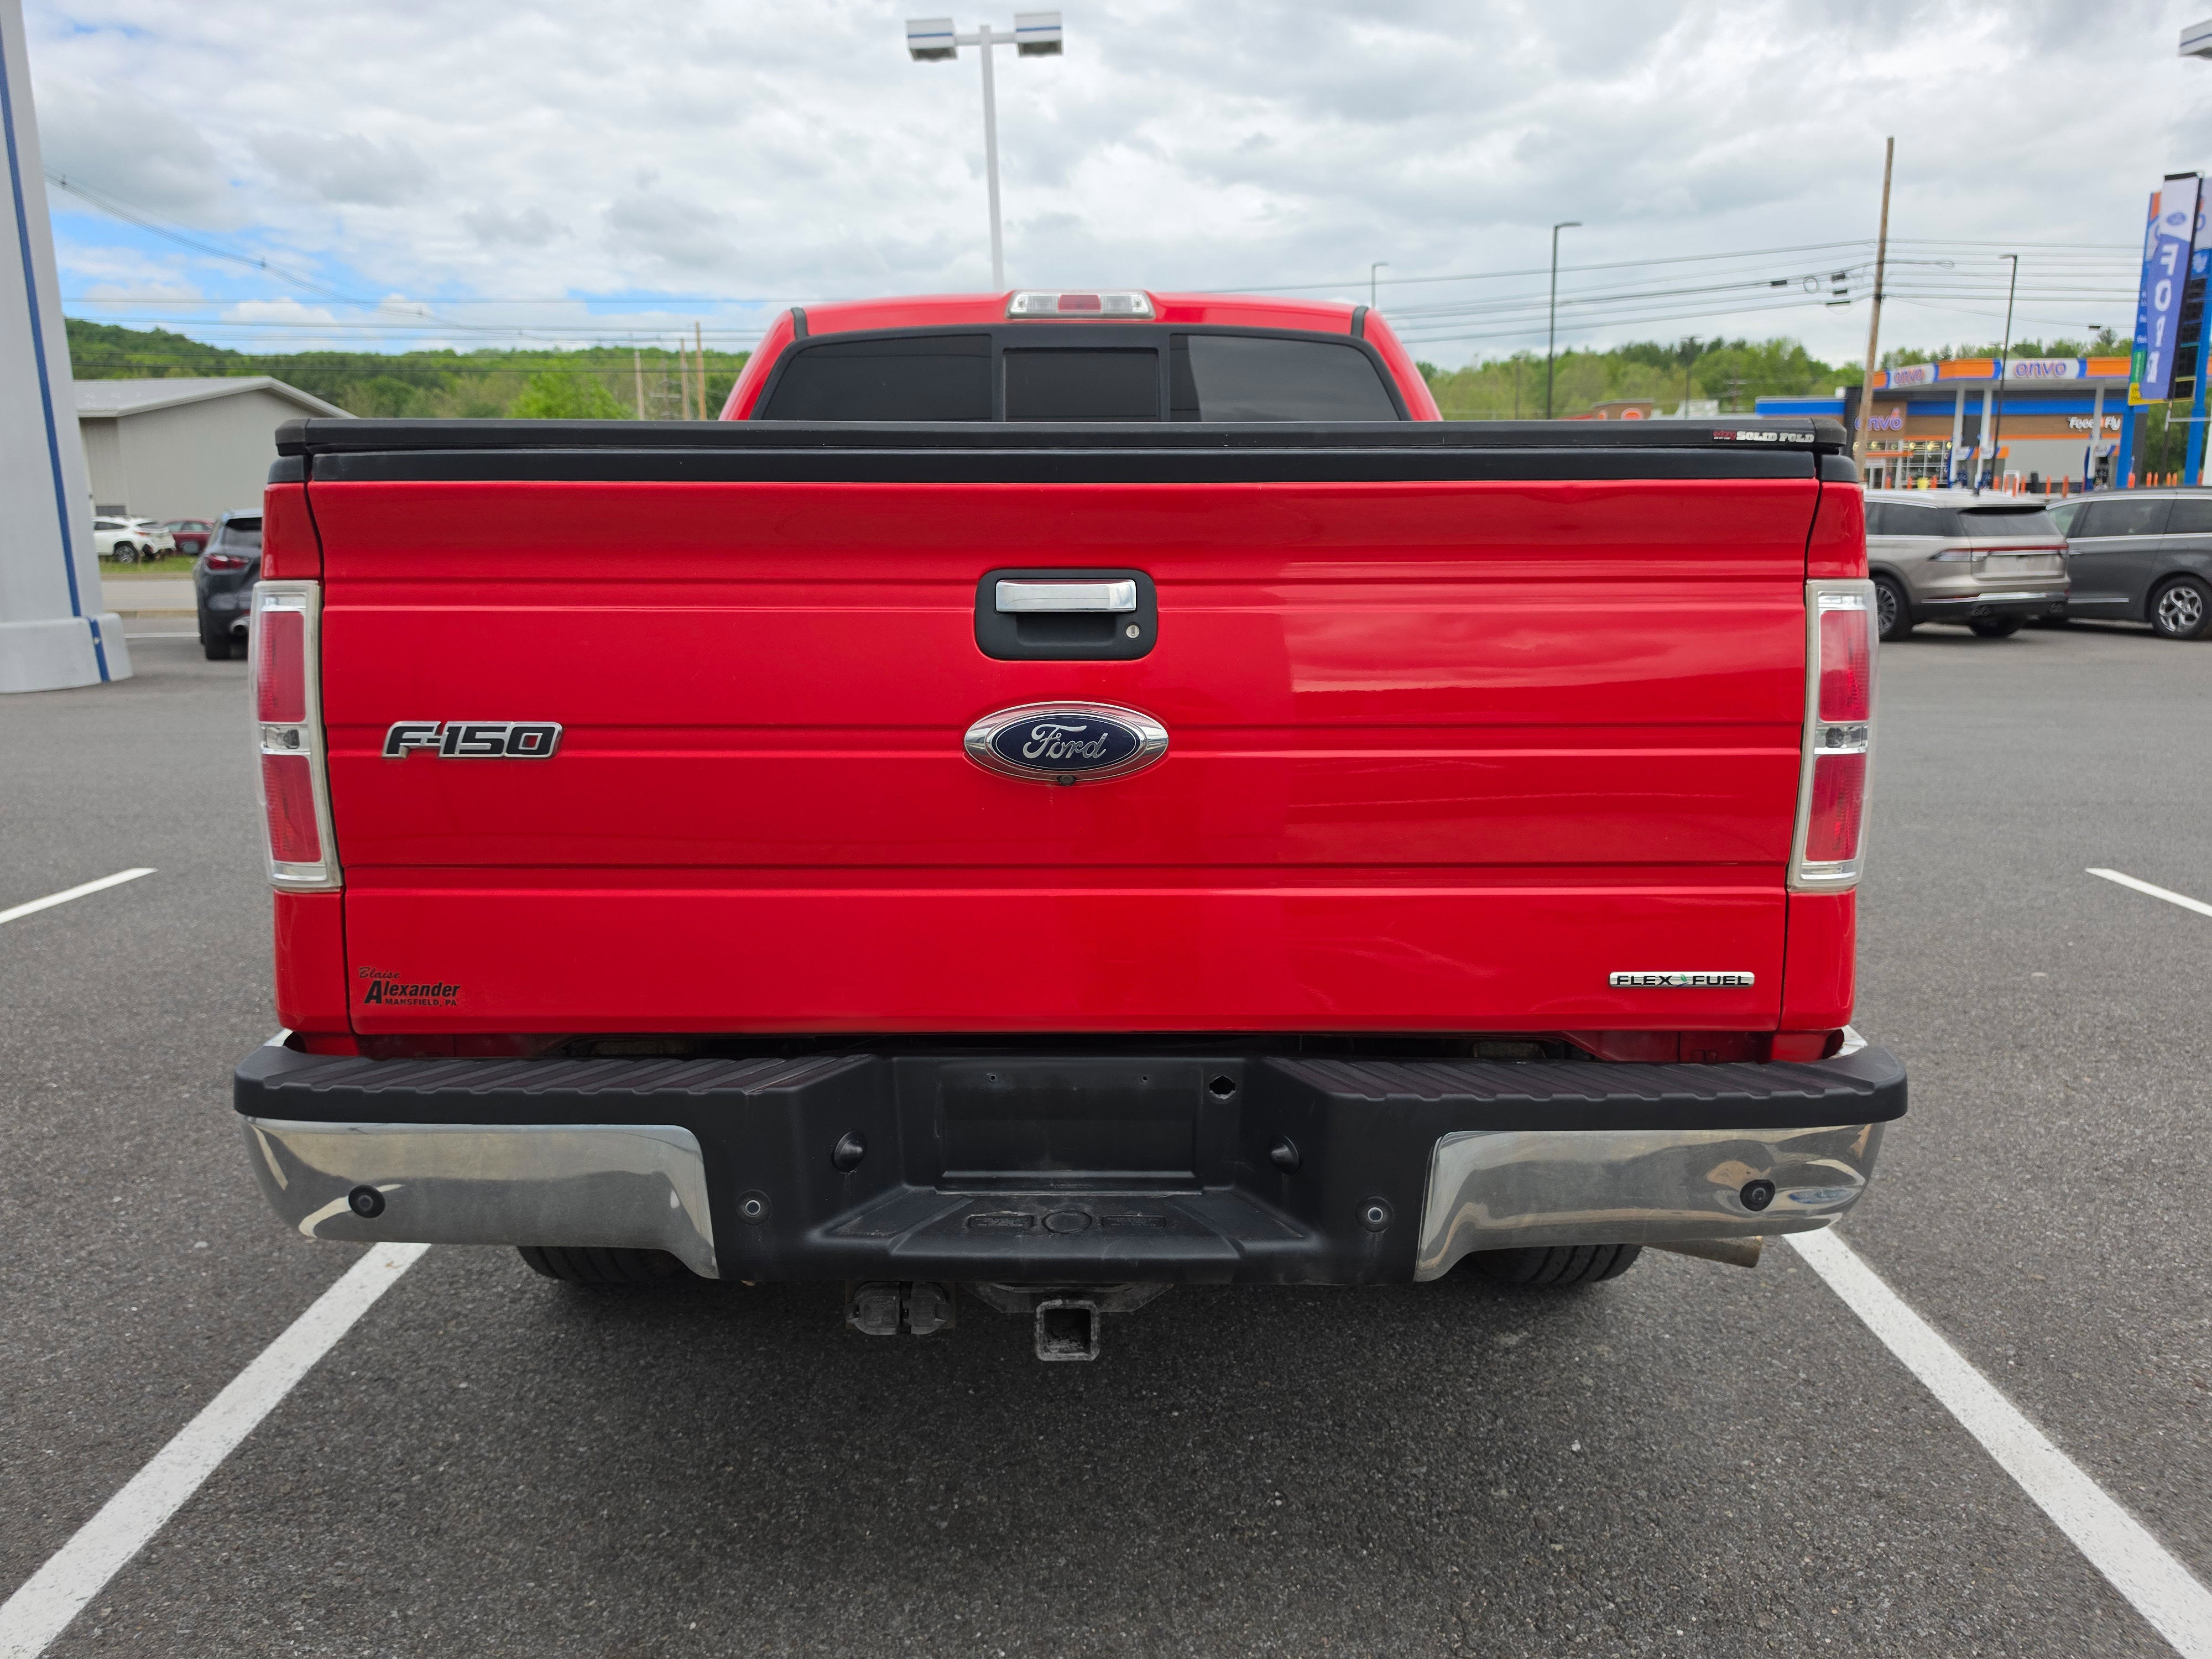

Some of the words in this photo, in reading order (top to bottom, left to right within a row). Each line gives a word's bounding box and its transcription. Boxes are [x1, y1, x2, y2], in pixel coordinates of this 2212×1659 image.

[1894, 368, 1923, 384] onvo
[2014, 361, 2067, 378] onvo
[1736, 431, 1777, 441] SOLID
[1778, 432, 1814, 442] FOLD
[382, 721, 562, 758] F-150
[1022, 723, 1108, 759] Ford
[358, 967, 400, 979] Blaise
[1616, 975, 1672, 985] FLEX
[1692, 975, 1749, 985] FUEL
[363, 980, 461, 1004] Alexander
[385, 998, 442, 1006] MANSFIELD,
